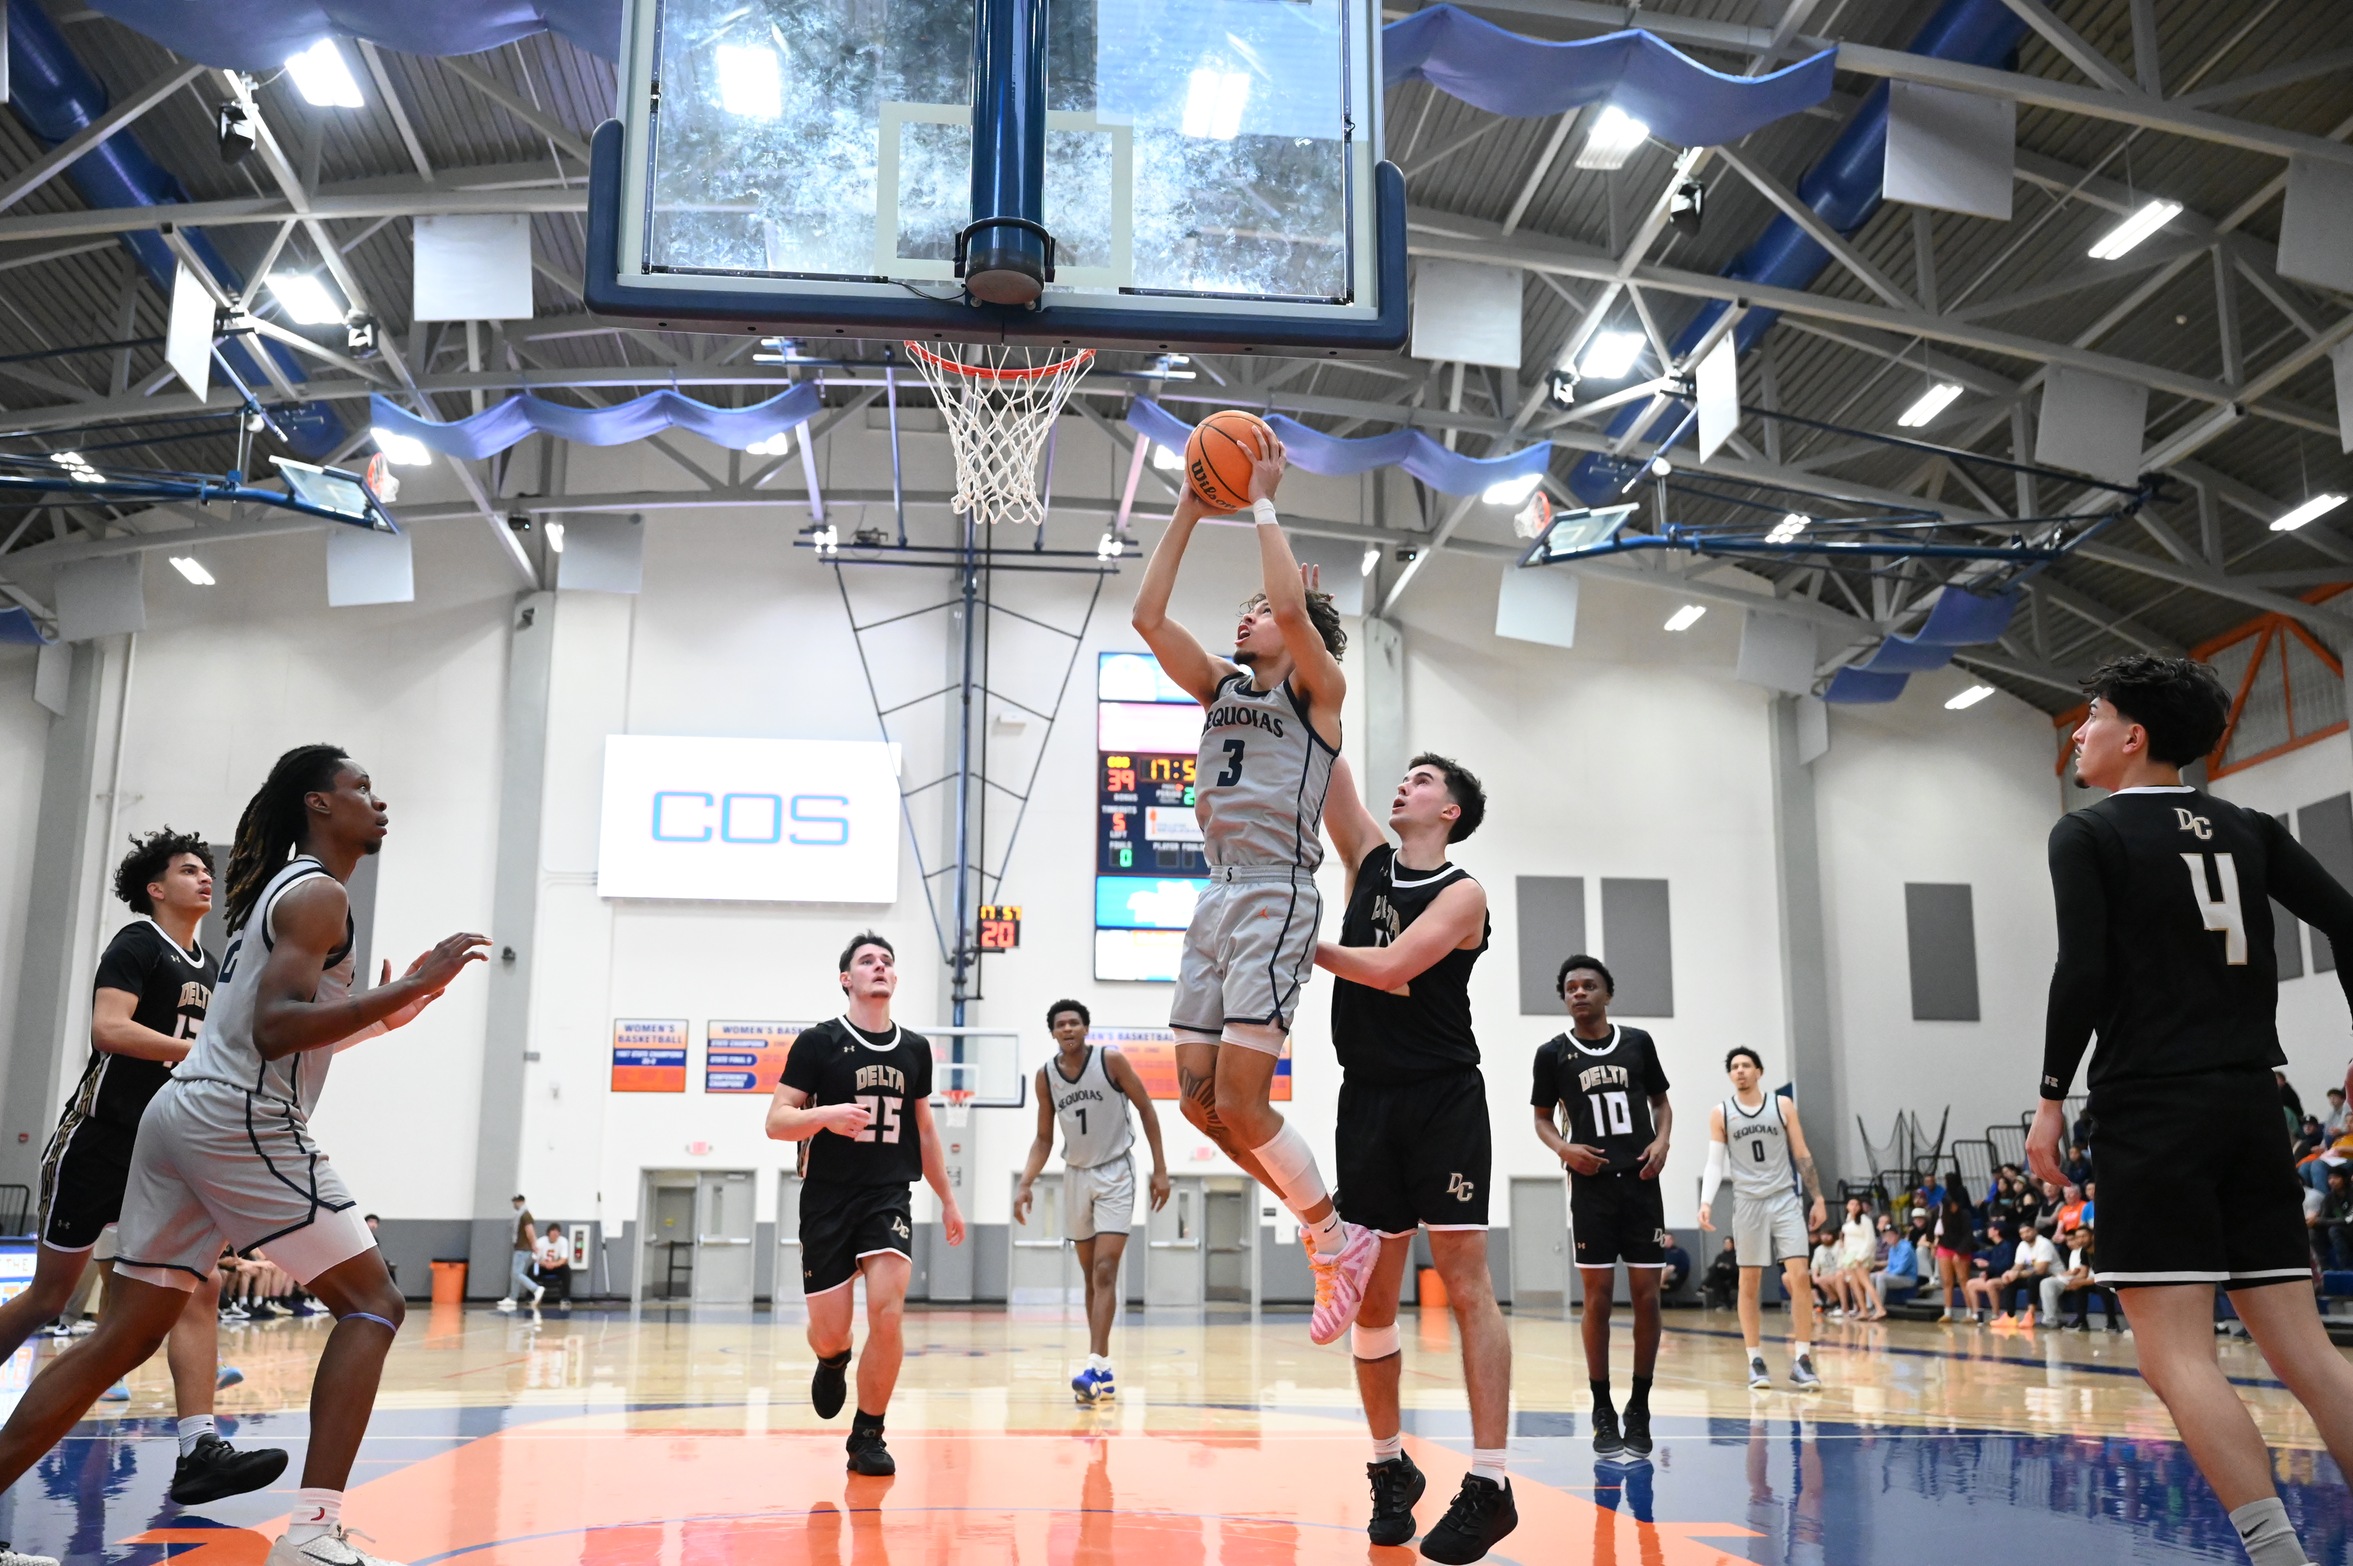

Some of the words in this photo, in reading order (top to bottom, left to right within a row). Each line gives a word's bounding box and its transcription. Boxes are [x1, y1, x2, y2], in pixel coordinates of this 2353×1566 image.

[1192, 459, 1236, 509] Wilson
[1217, 739, 1245, 787] 3
[1107, 769, 1135, 791] 39
[652, 791, 849, 845] COS
[1112, 813, 1126, 831] 5
[2174, 808, 2213, 840] DC
[1120, 848, 1133, 867] 0
[2179, 852, 2248, 966] 4
[981, 921, 1015, 948] 20
[618, 1034, 682, 1044] BASKETBALL
[855, 1064, 905, 1094] DELTA
[1578, 1064, 1629, 1092] DELTA
[1058, 1089, 1104, 1112] SEQUOIAS
[1587, 1090, 1634, 1137] 10
[854, 1095, 904, 1144] 25
[1076, 1108, 1087, 1135] 7
[1733, 1124, 1778, 1141] SEQUOIAS
[1752, 1140, 1765, 1162] 0
[1446, 1172, 1474, 1202] DC
[891, 1216, 910, 1240] DC
